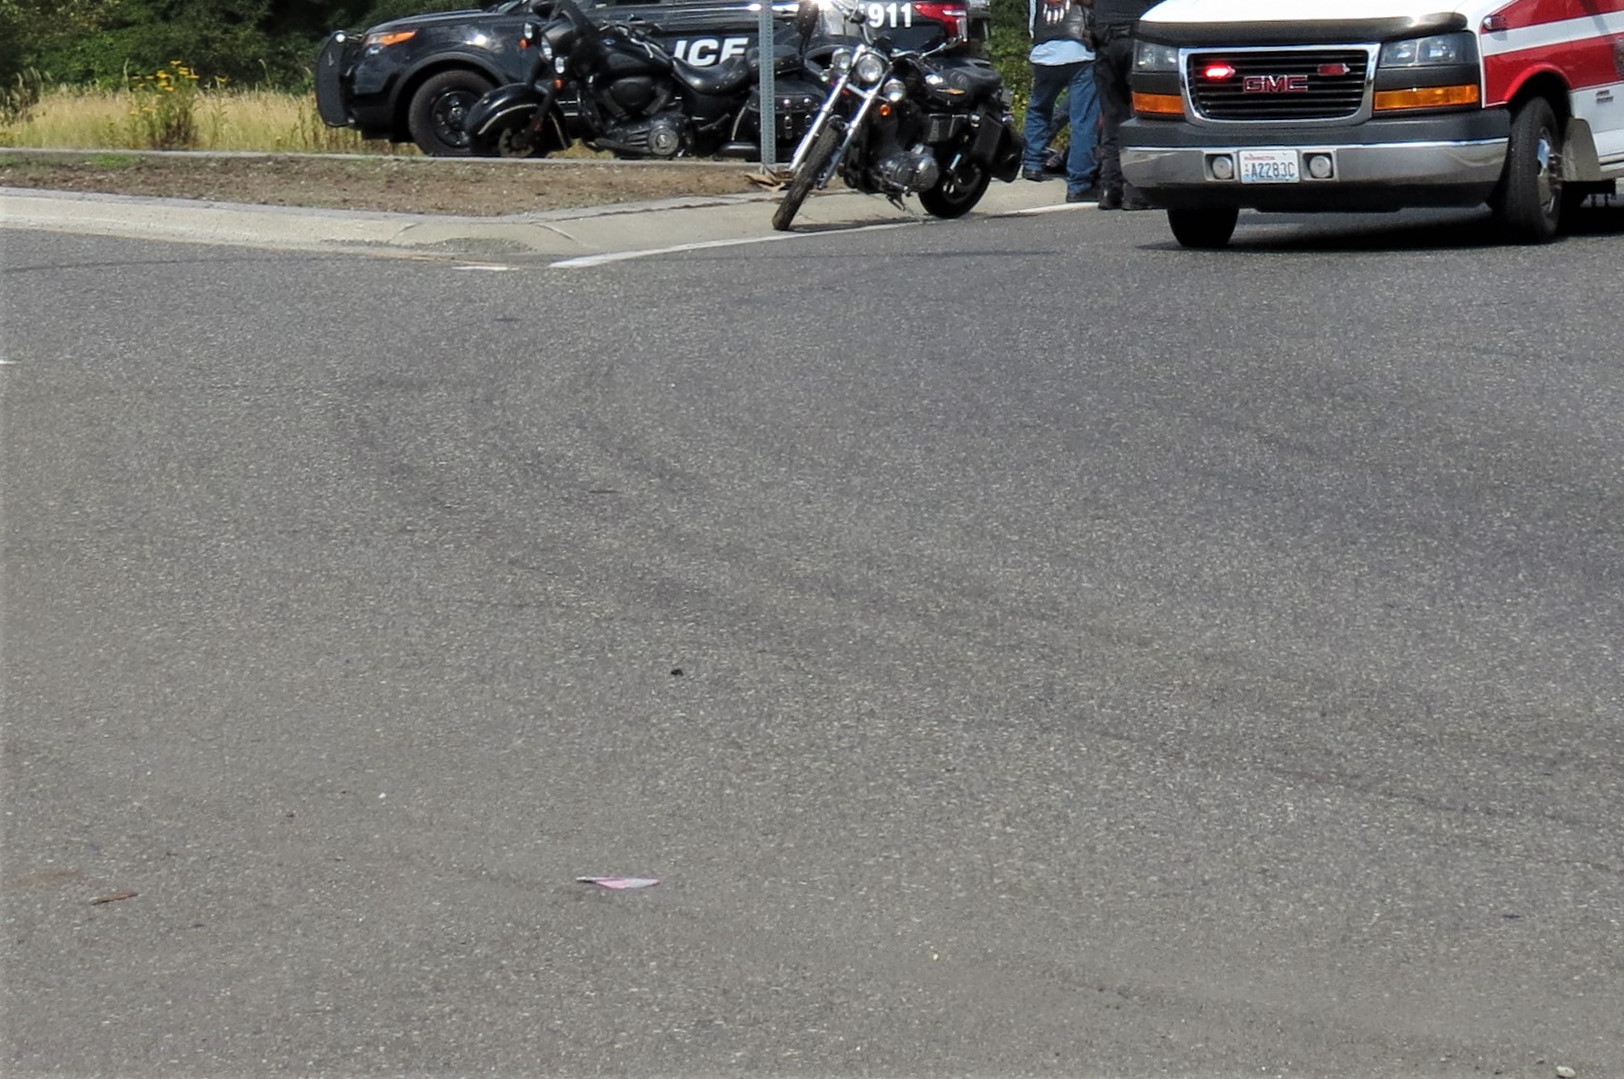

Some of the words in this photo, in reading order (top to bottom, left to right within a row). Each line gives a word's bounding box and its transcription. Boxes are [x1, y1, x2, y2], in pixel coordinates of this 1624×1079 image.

[868, 3, 912, 28] 911
[673, 37, 749, 67] ICE
[1243, 75, 1308, 93] GMC
